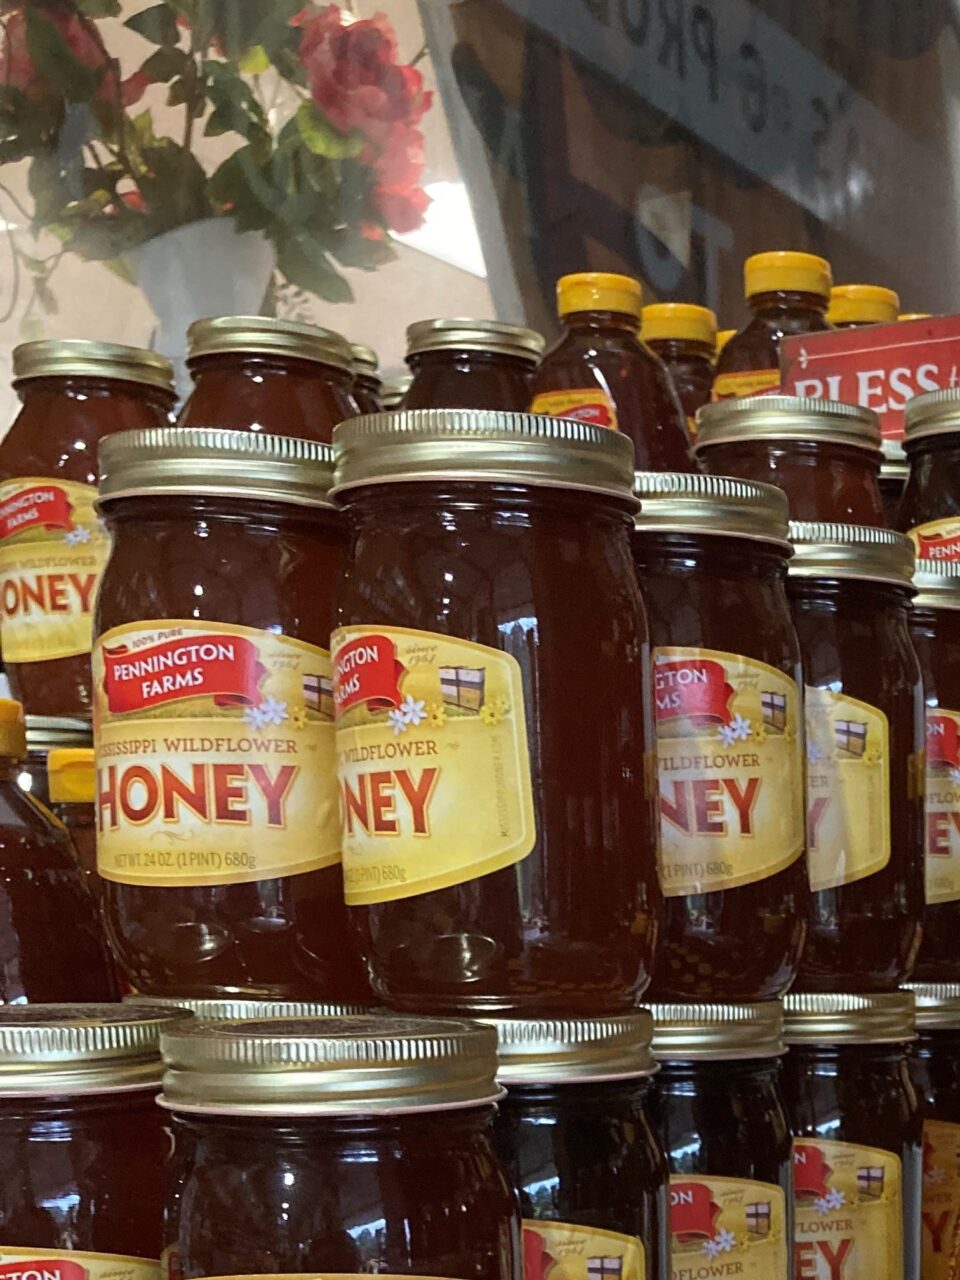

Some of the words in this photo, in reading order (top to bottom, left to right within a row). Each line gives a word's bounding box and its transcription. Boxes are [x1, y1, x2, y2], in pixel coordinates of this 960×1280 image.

[2, 574, 97, 615] ONEY
[132, 634, 155, 649] 100%
[157, 628, 184, 641] PURE
[114, 644, 234, 681] PENNINGTON
[337, 645, 379, 675] NGTON
[142, 668, 204, 699] FARMS
[102, 739, 157, 758] SSISSIPPI
[163, 738, 298, 754] WILDFLOWER
[99, 763, 299, 833] HONEY
[343, 767, 440, 837] NEY
[659, 777, 761, 836] NEY
[190, 852, 222, 869] PINT)
[225, 852, 256, 869] 680g
[795, 1218, 854, 1233] FLOWER
